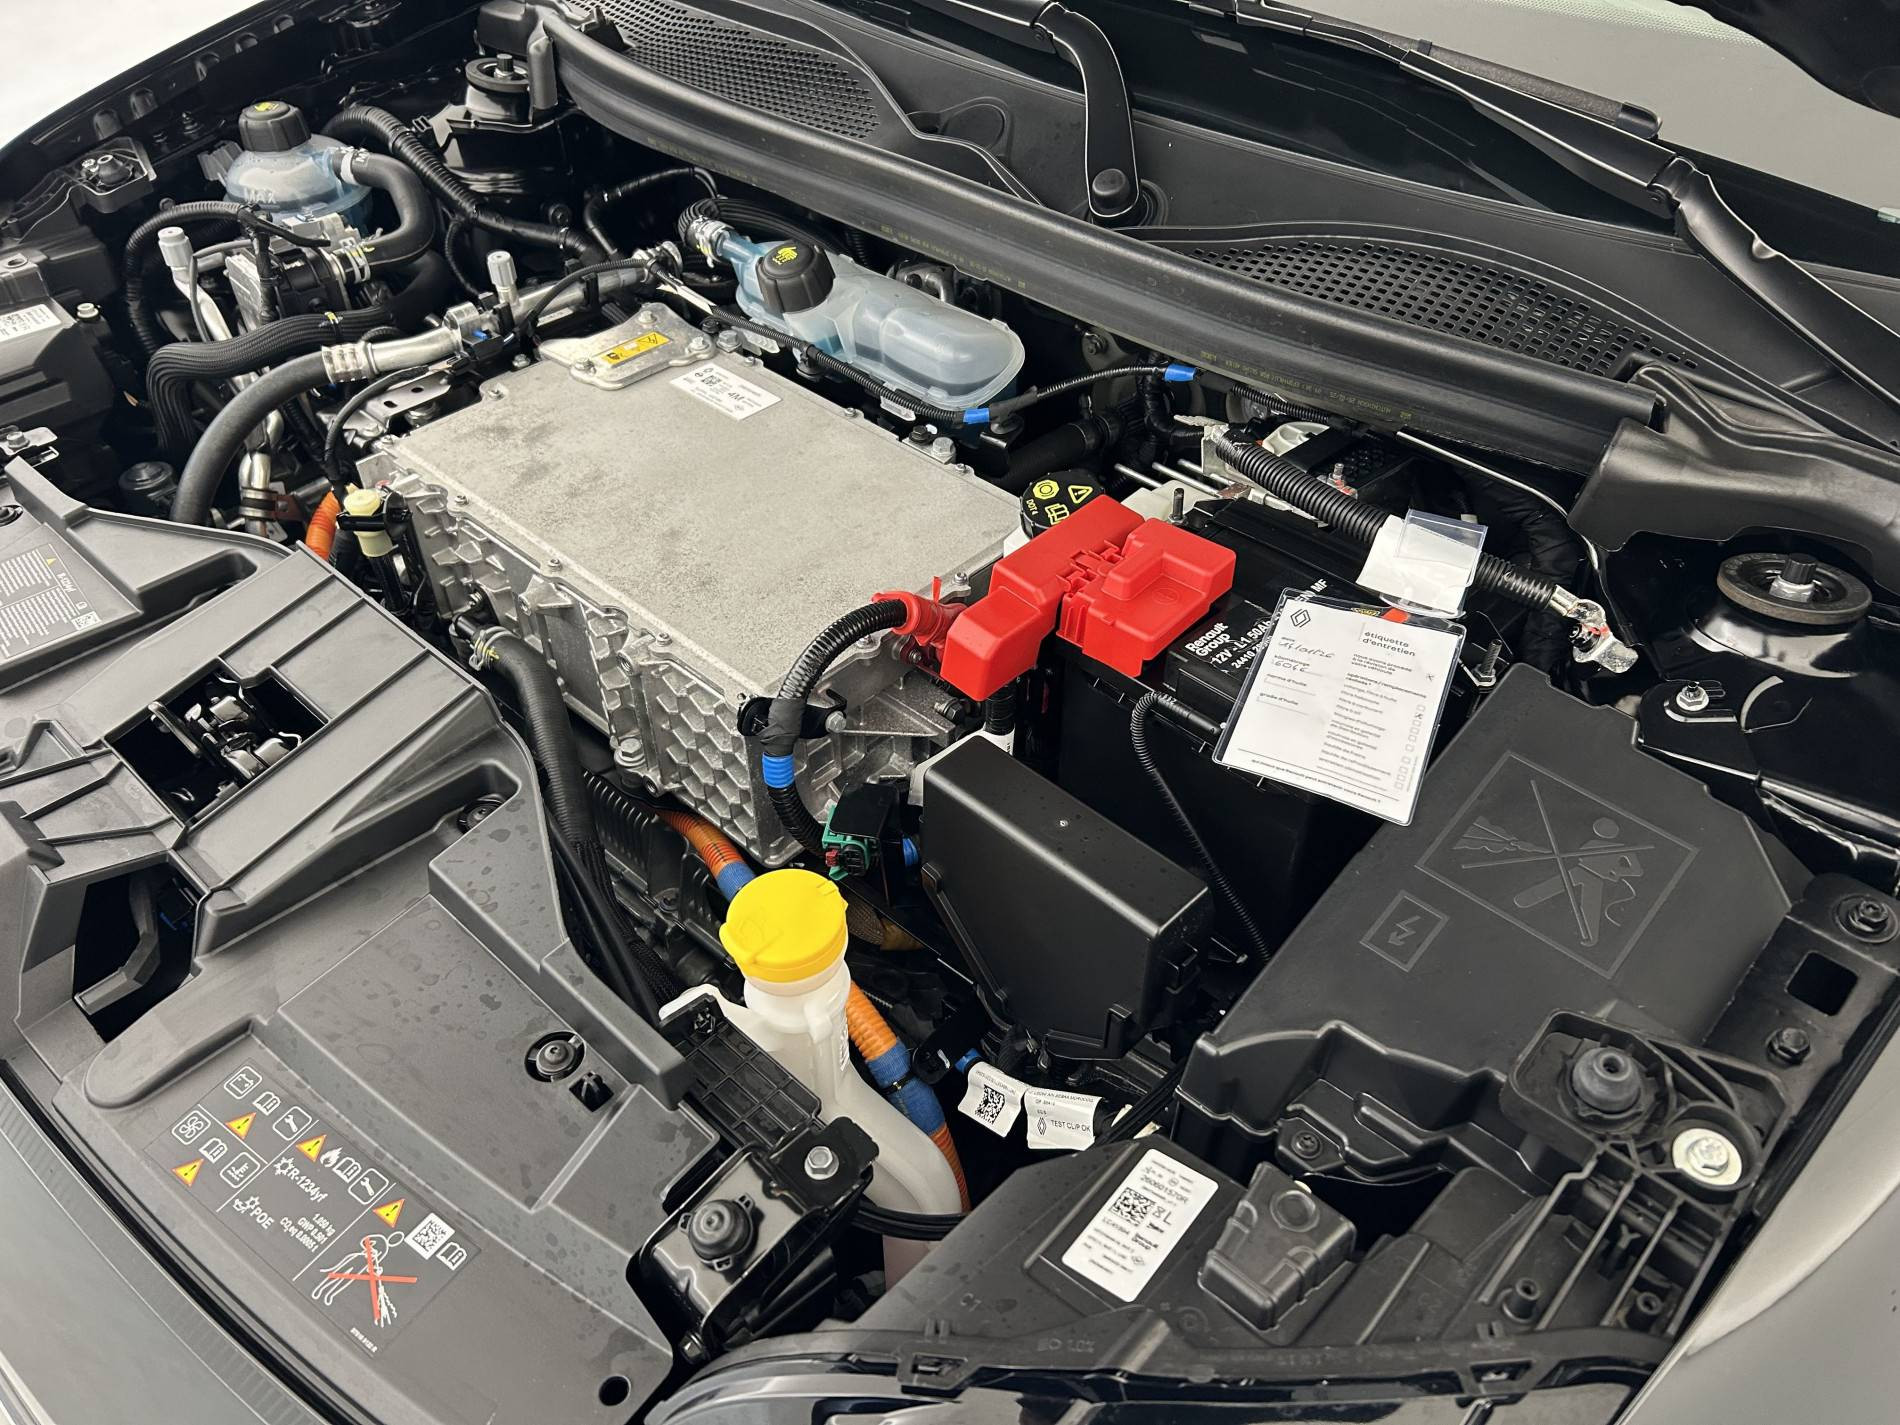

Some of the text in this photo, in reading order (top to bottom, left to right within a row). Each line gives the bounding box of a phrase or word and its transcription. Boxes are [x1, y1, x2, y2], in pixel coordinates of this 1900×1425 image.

[1211, 649, 1233, 664] 12V
[1234, 637, 1250, 650] L1
[1310, 579, 1328, 593] MF
[1184, 622, 1229, 652] Renault
[1194, 633, 1230, 657] Group
[1362, 638, 1416, 657] d'entretien
[1364, 631, 1410, 648] étiquette
[1231, 650, 1255, 669] 24410
[1050, 1119, 1091, 1133] TEST CLIP OK
[287, 1167, 328, 1203] R-1234yf
[250, 1207, 275, 1230] POE
[297, 1217, 314, 1233] GWP
